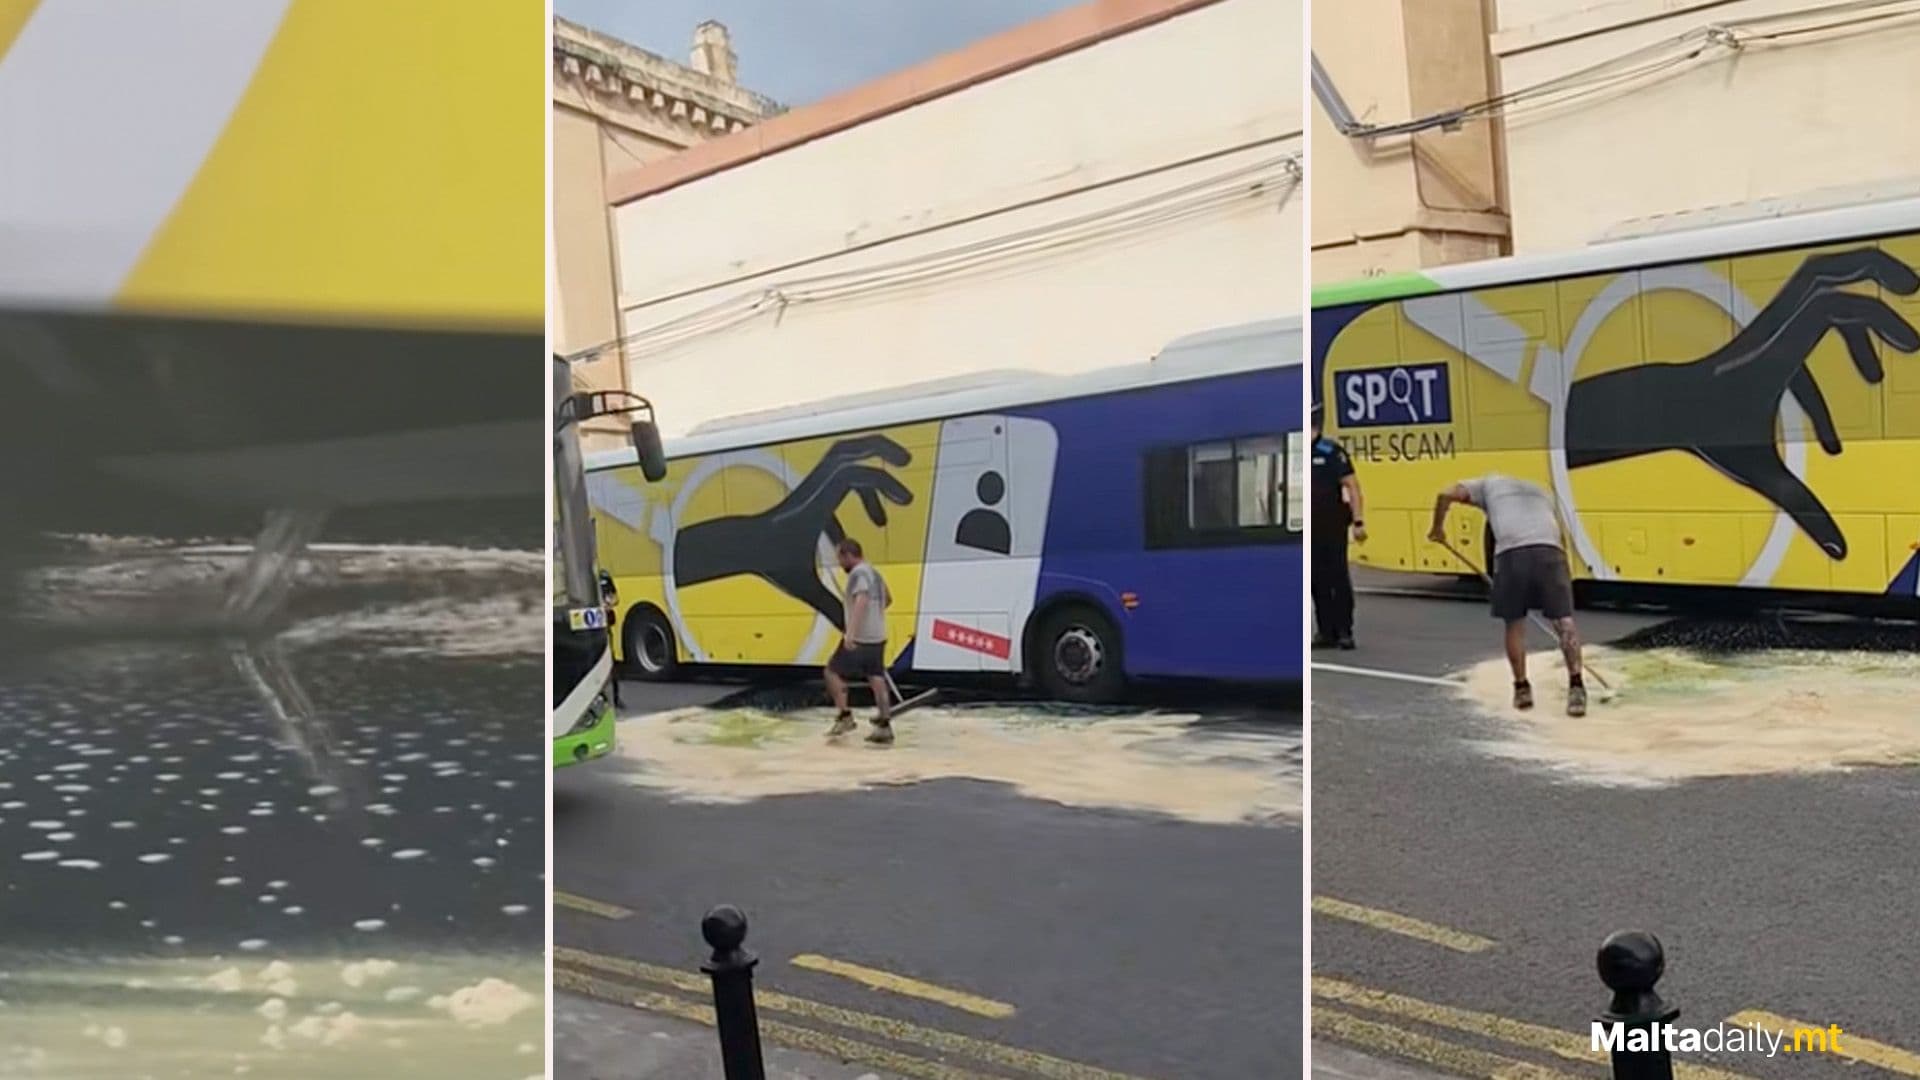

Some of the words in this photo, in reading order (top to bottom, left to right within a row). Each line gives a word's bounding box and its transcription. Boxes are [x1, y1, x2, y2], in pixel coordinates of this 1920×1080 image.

[1346, 368, 1438, 422] SPOT
[1338, 433, 1383, 462] THE
[1388, 431, 1456, 462] SCAM
